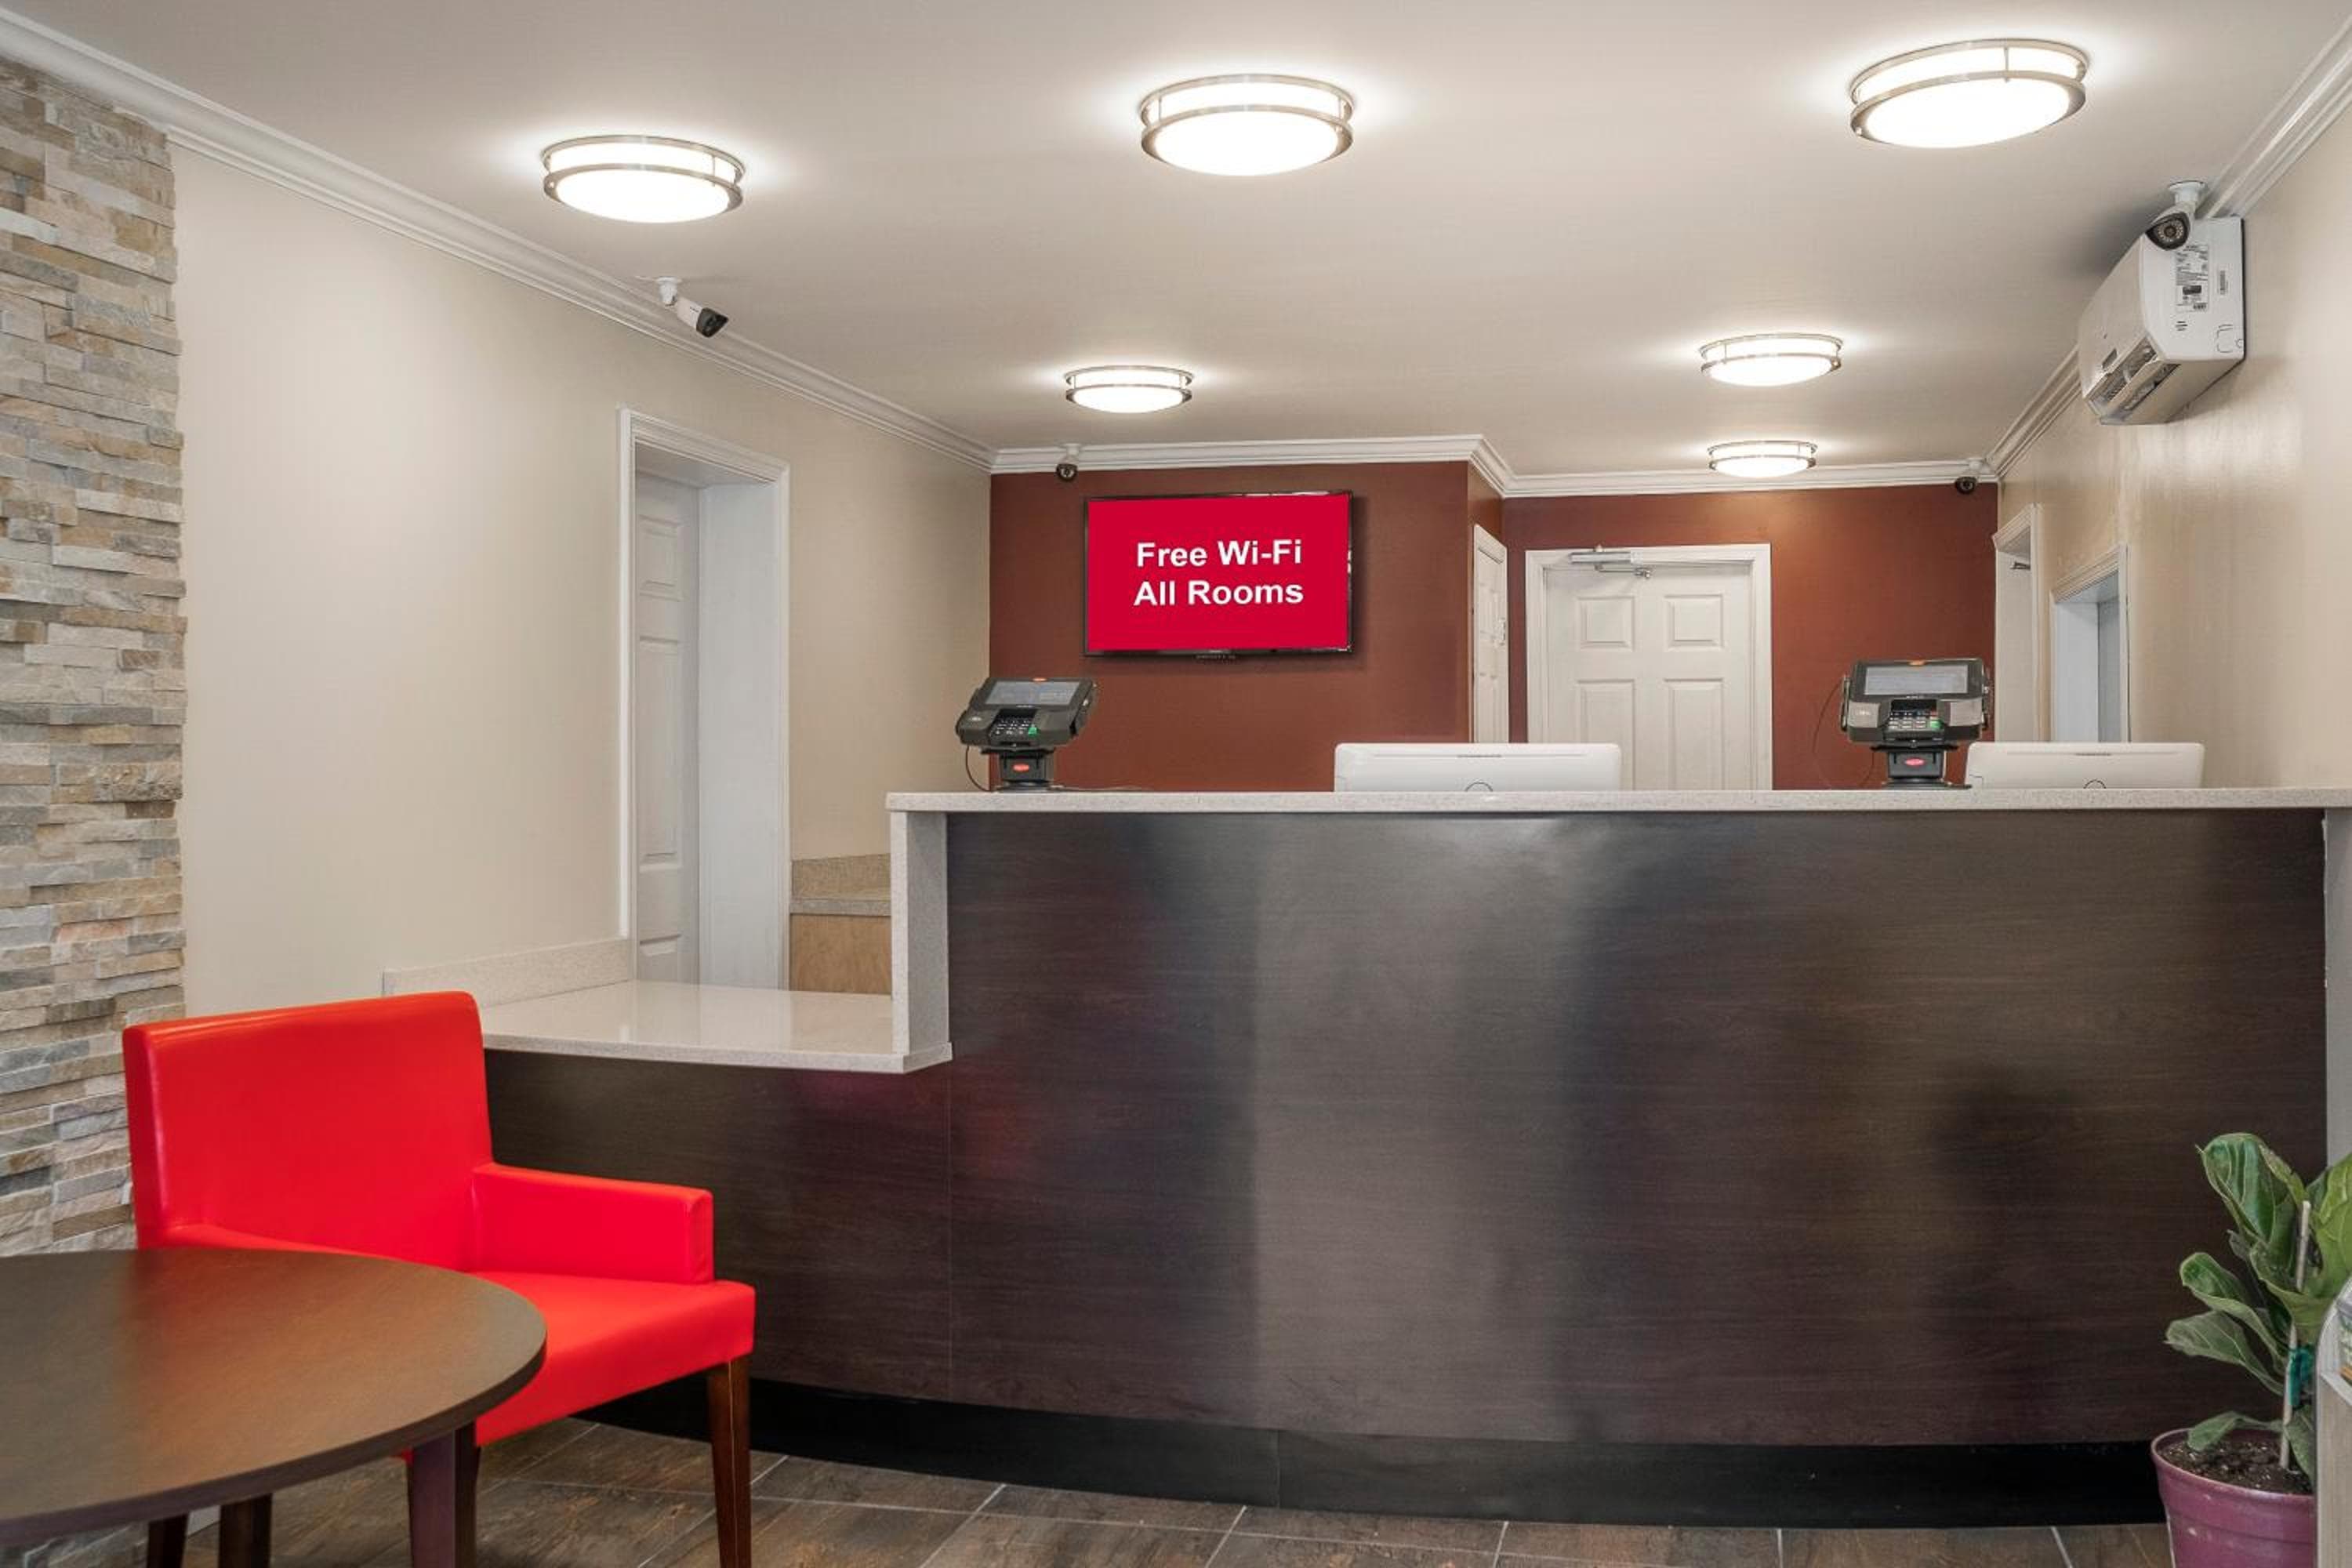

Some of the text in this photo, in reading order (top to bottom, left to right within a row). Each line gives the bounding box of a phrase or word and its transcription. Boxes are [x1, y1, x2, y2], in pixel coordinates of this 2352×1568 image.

[1137, 539, 1301, 567] Free Wi-Fi
[1133, 580, 1304, 606] All Rooms
